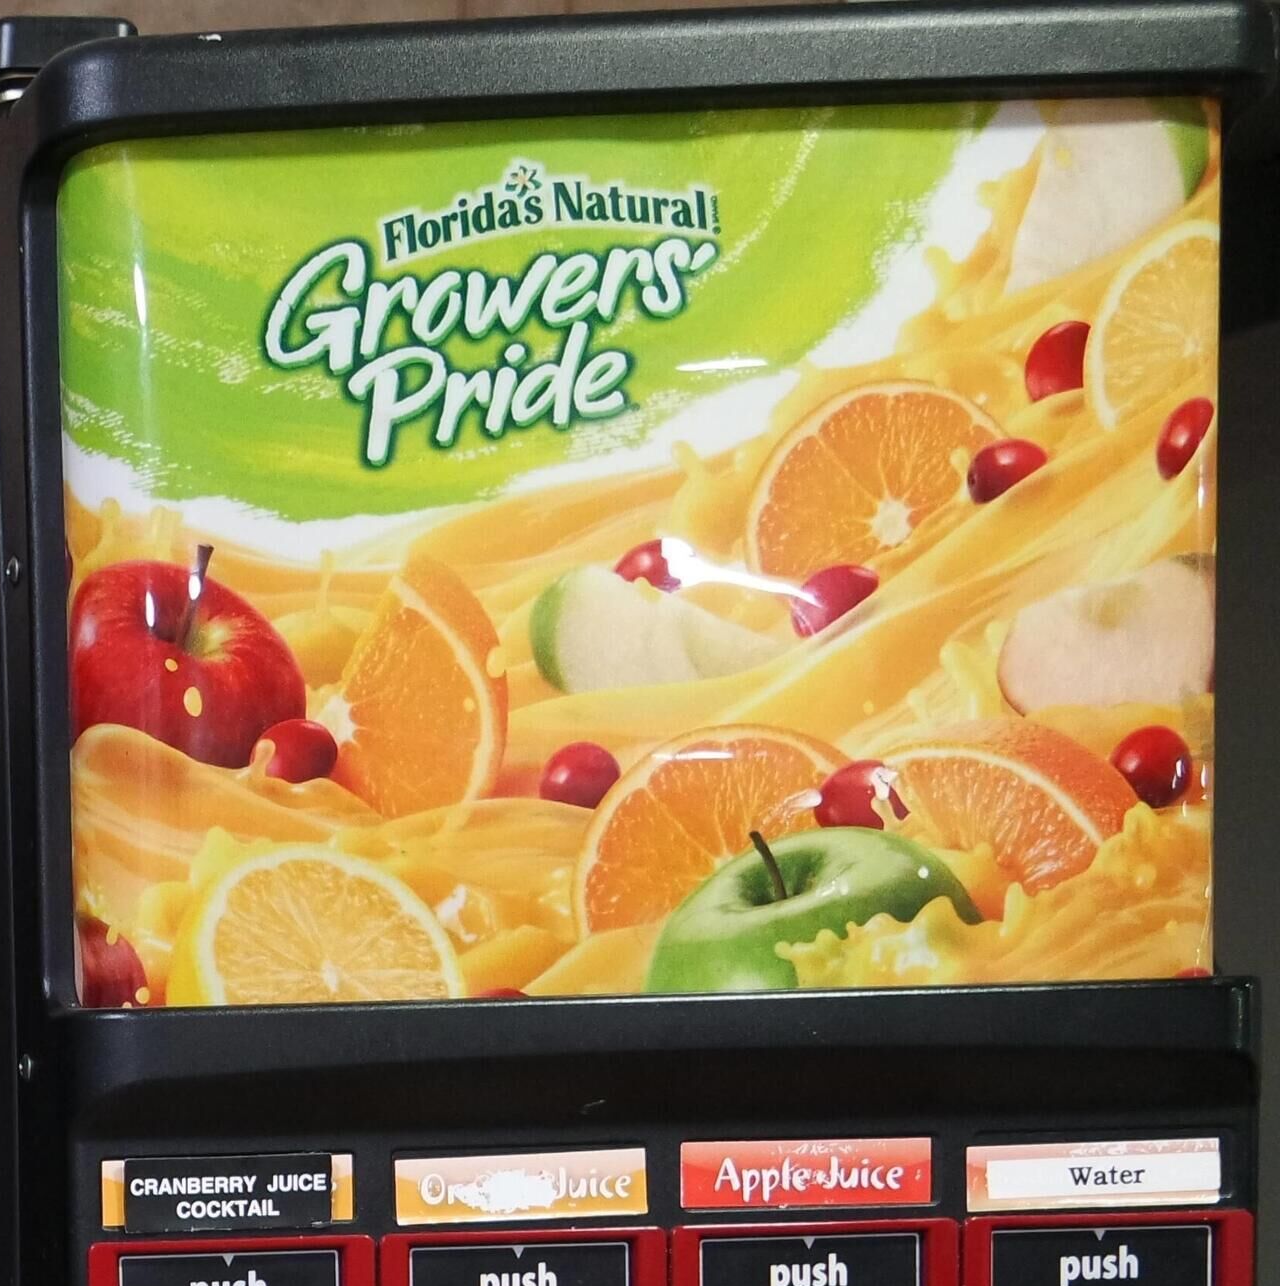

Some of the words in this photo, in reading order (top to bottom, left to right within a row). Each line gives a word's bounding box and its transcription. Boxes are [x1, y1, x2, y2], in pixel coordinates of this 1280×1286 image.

[348, 322, 628, 467] Pride
[130, 1176, 257, 1196] CRANBERRY
[267, 1174, 327, 1193] JUICE
[554, 1167, 632, 1199] Juice
[714, 1157, 807, 1203] Apple
[822, 1156, 904, 1190] Juice
[1069, 1164, 1146, 1187] Water
[176, 1199, 280, 1219] COCKTAIL
